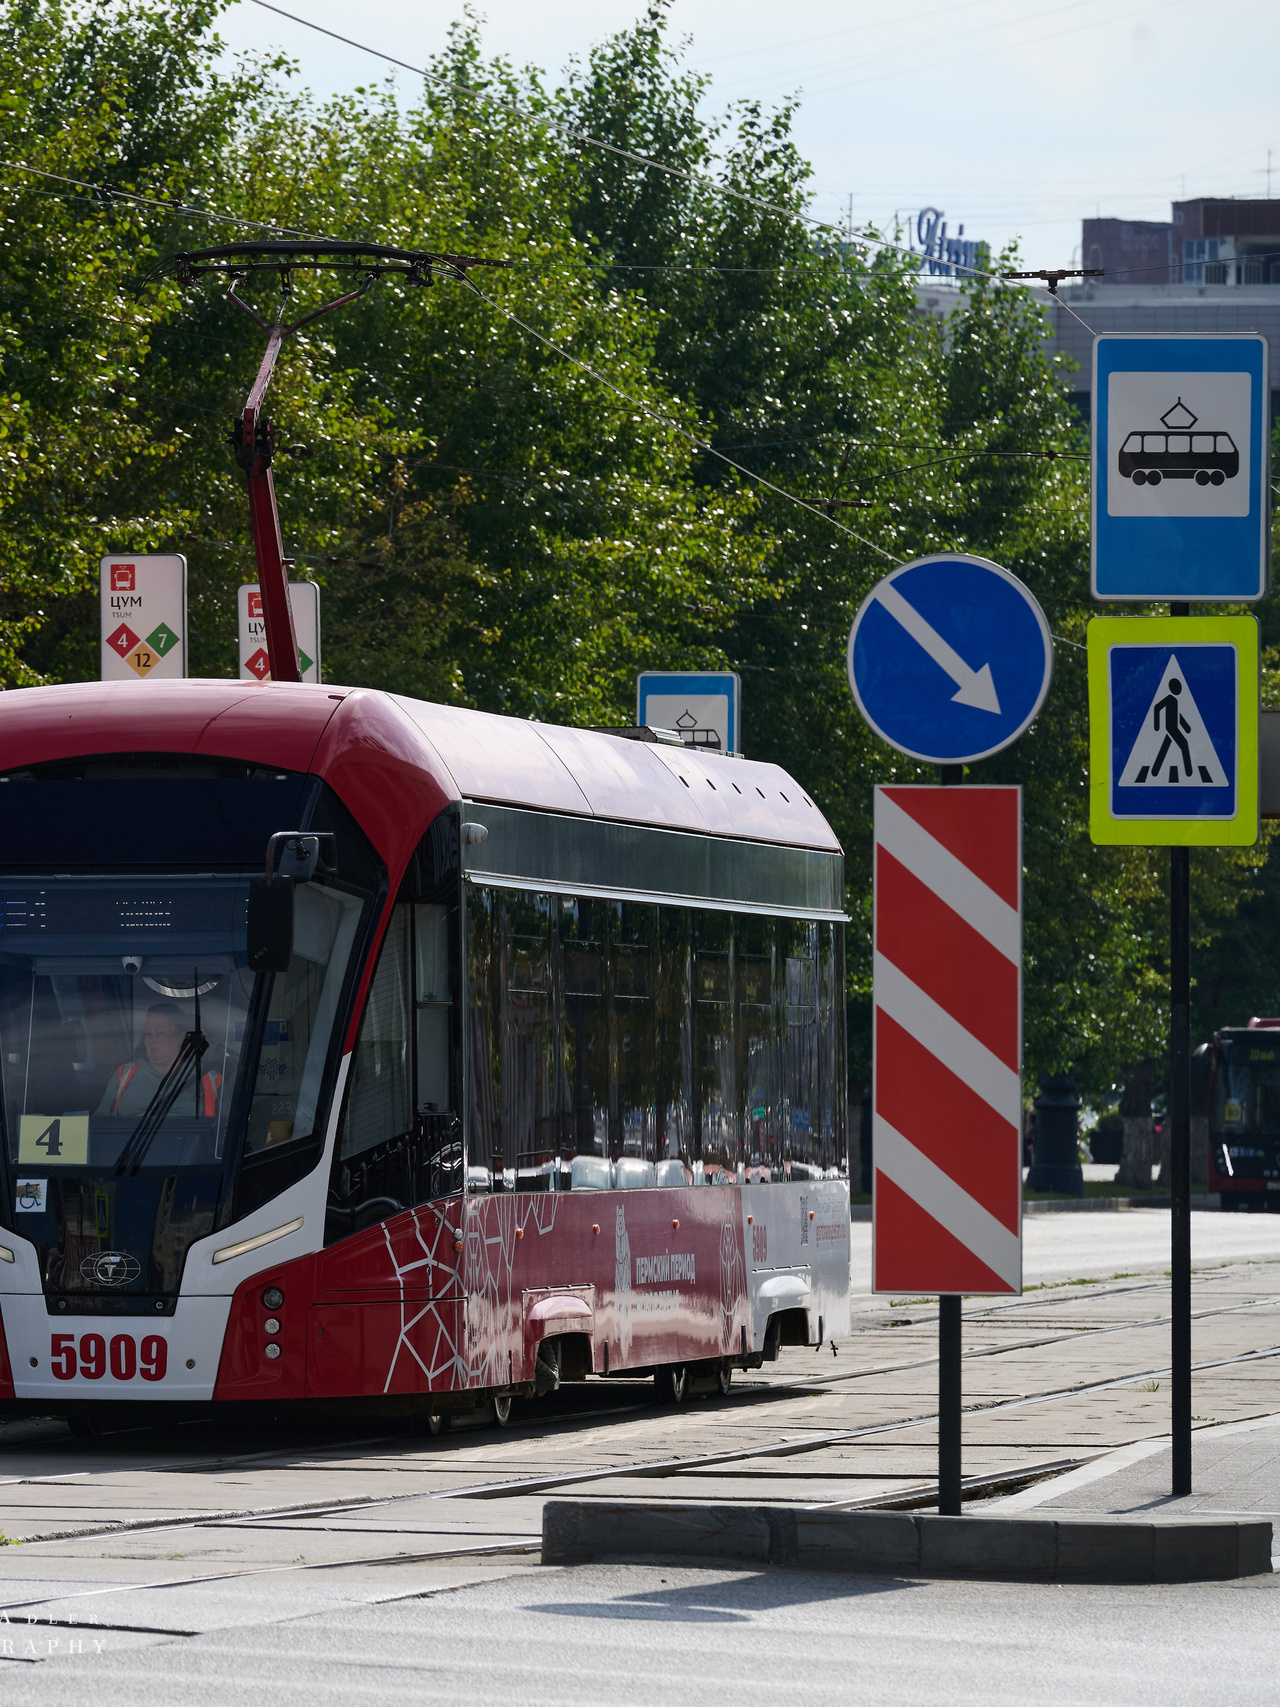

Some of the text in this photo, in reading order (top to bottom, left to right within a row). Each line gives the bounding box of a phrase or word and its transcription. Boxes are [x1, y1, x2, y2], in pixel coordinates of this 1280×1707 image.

[110, 596, 142, 610] ЦУМ
[111, 611, 132, 619] TSUM
[248, 622, 266, 635] ЦУ
[117, 633, 168, 648] 4 7
[134, 653, 151, 668] 12
[254, 657, 265, 671] 4
[35, 1118, 64, 1156] 4
[636, 1248, 696, 1285] ПЕРМСКИЙ ПЕРИОД
[50, 1332, 168, 1382] 5909
